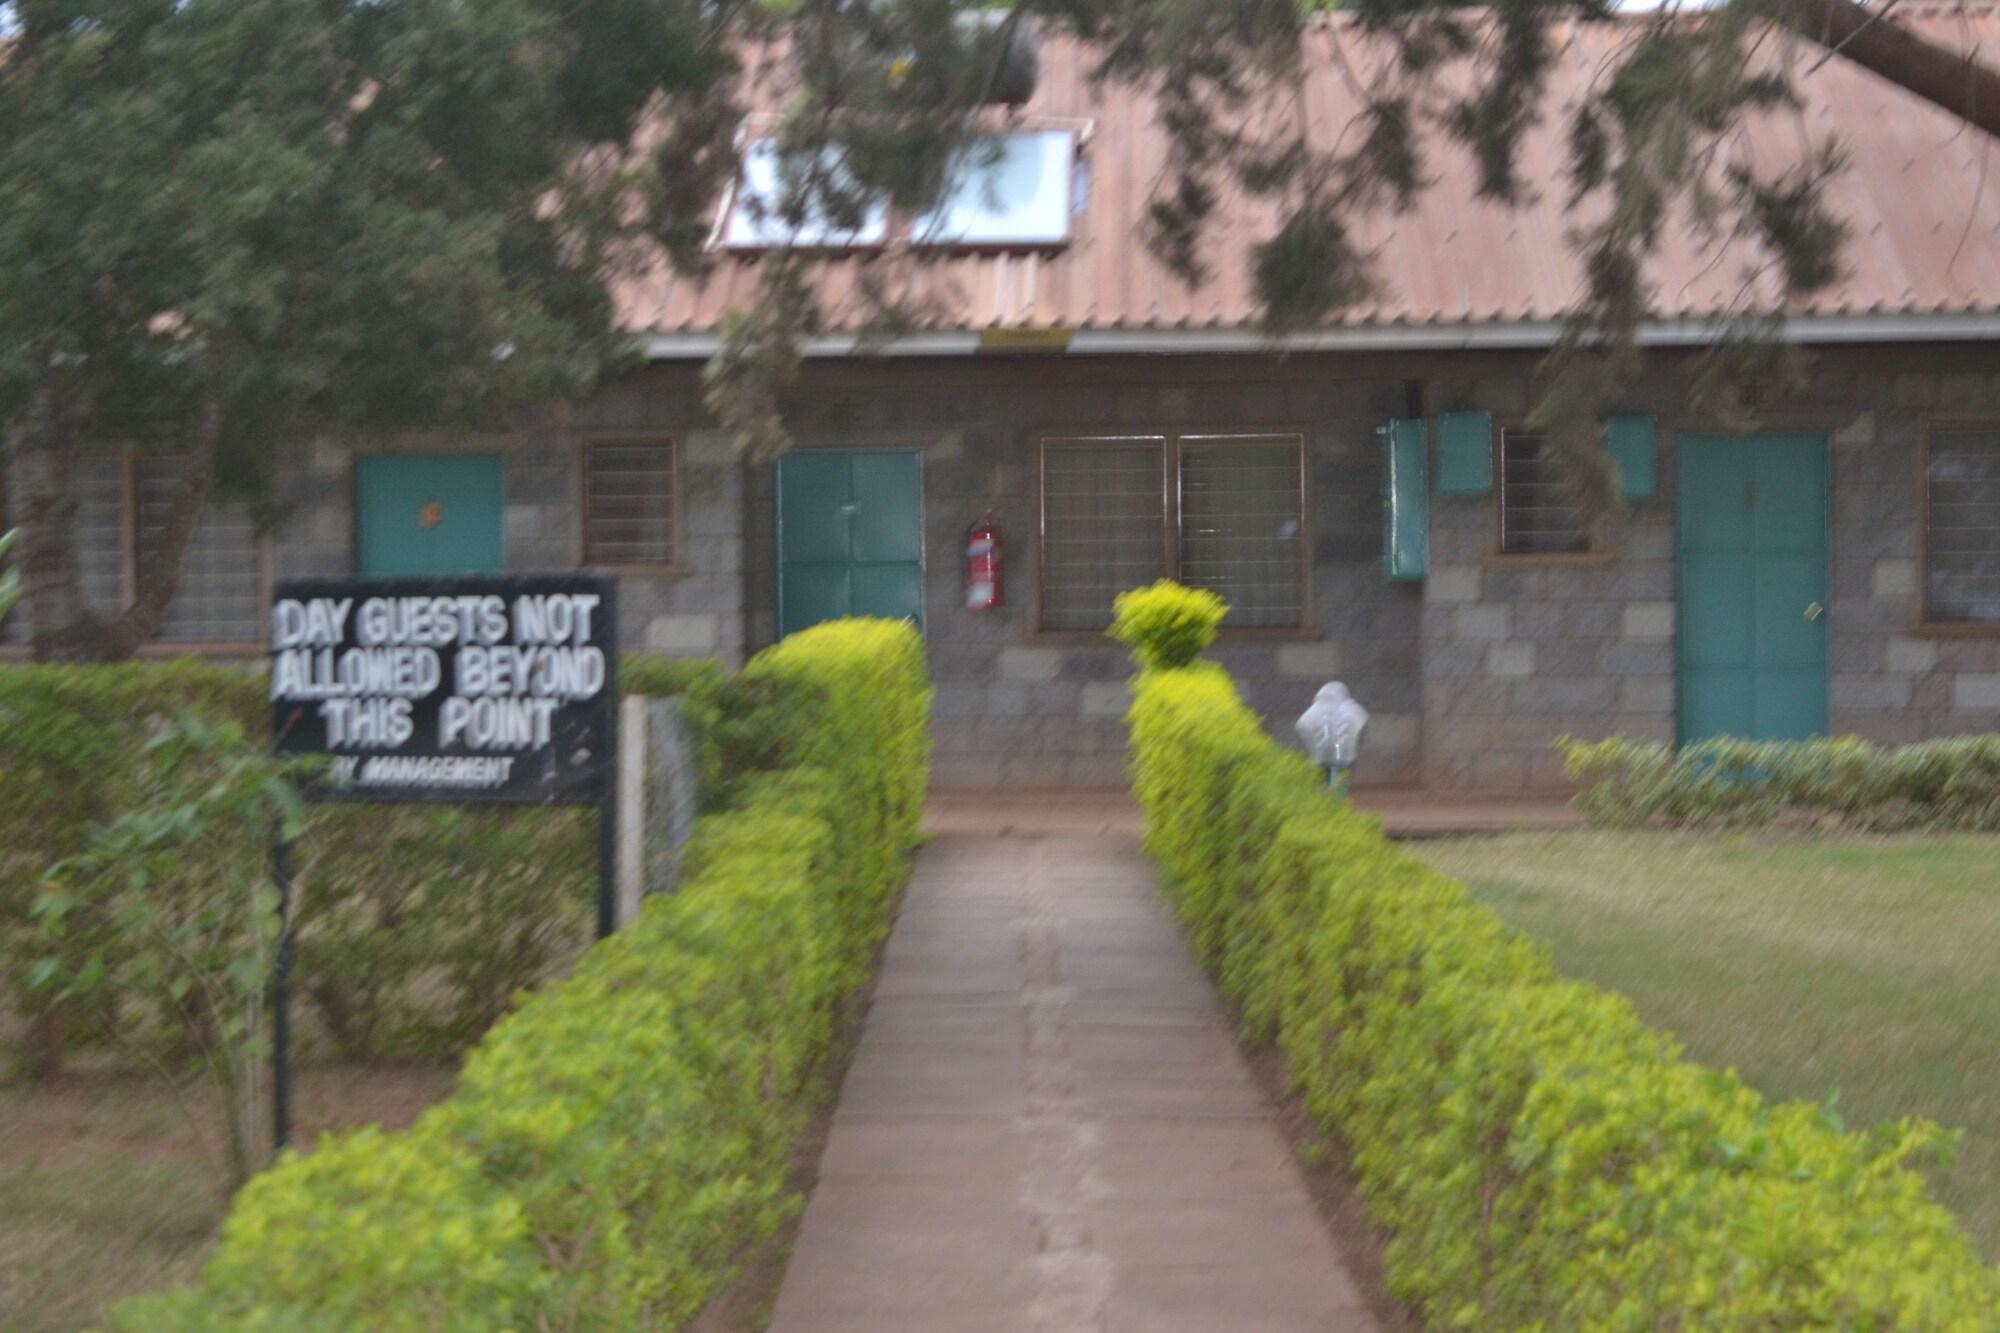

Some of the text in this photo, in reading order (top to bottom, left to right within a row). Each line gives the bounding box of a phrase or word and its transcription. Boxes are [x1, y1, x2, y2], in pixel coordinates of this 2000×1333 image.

[275, 594, 600, 647] DAY GUESTS NOT
[272, 645, 606, 699] ALLOWED BEYOND
[320, 698, 559, 748] THIS POINT
[360, 756, 514, 786] MANAGEMENT
